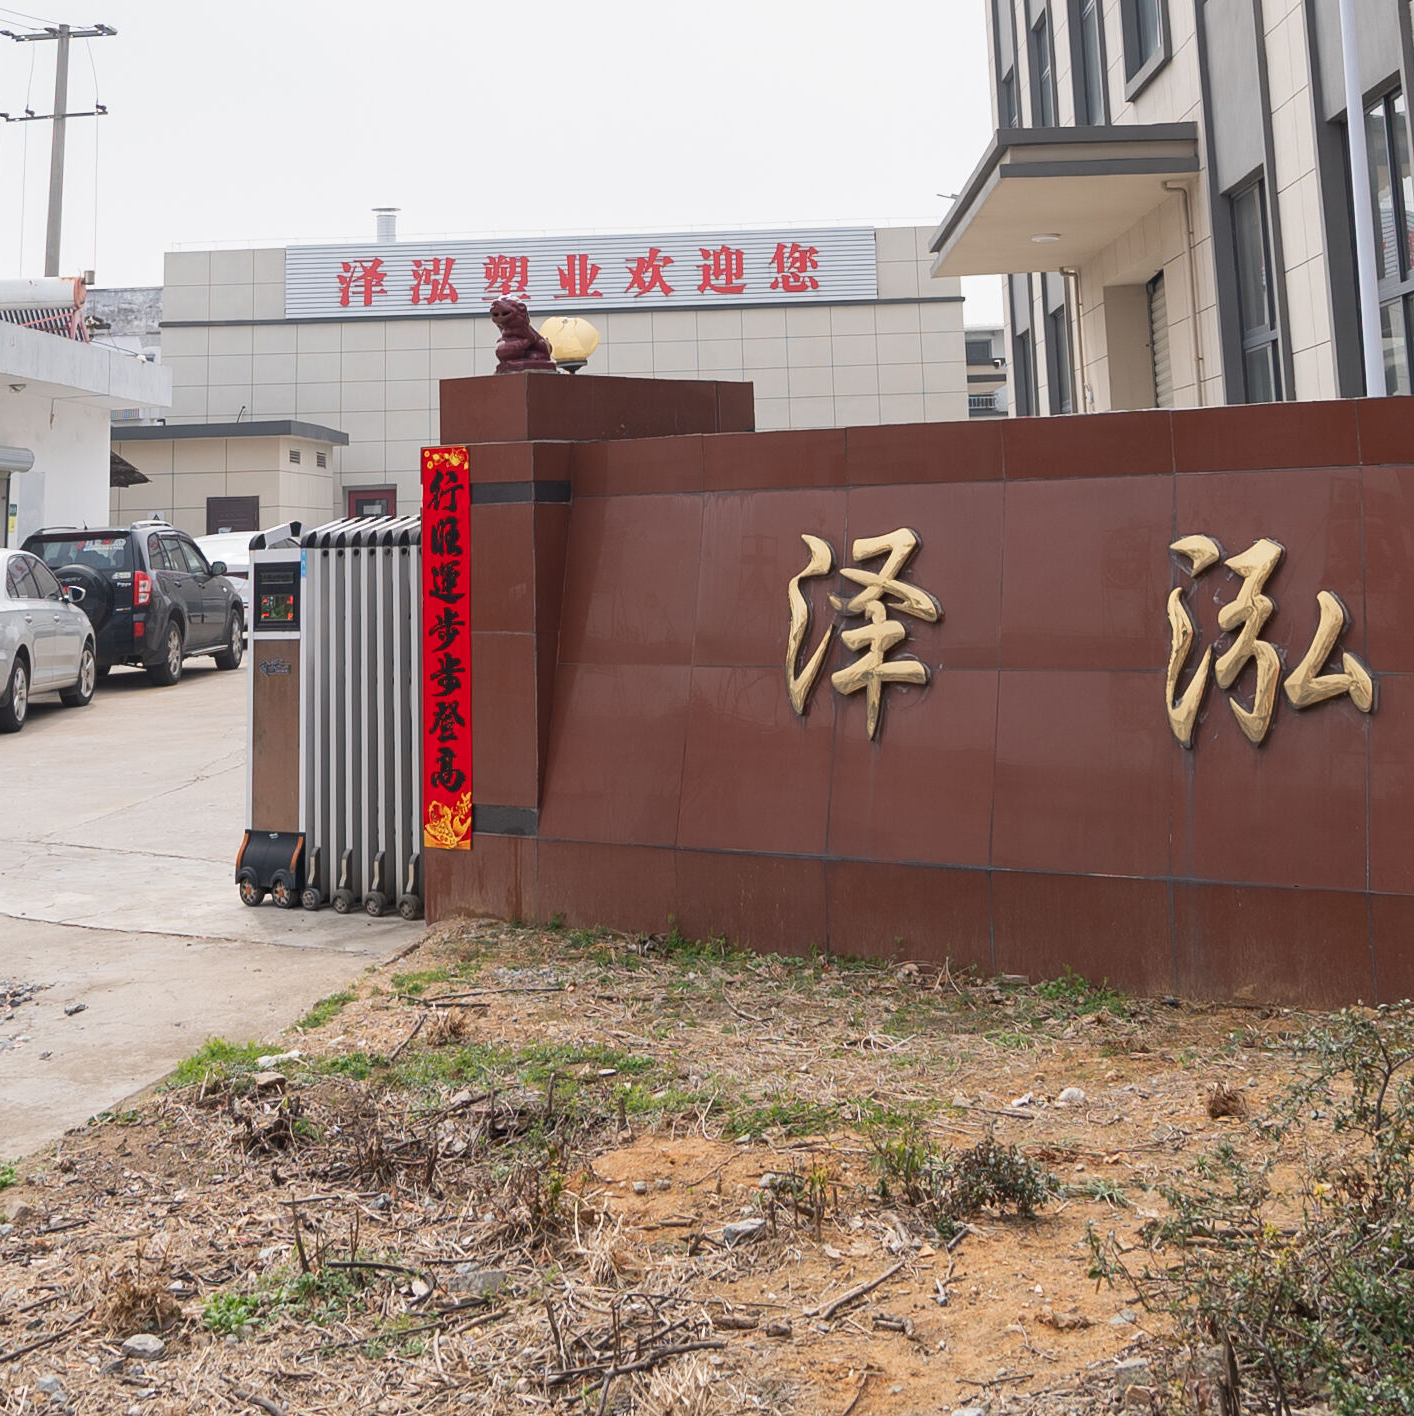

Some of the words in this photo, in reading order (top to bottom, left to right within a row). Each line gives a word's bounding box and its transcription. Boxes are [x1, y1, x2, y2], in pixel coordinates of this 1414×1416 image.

[336, 242, 820, 307] 泽泓塑业欢迎您
